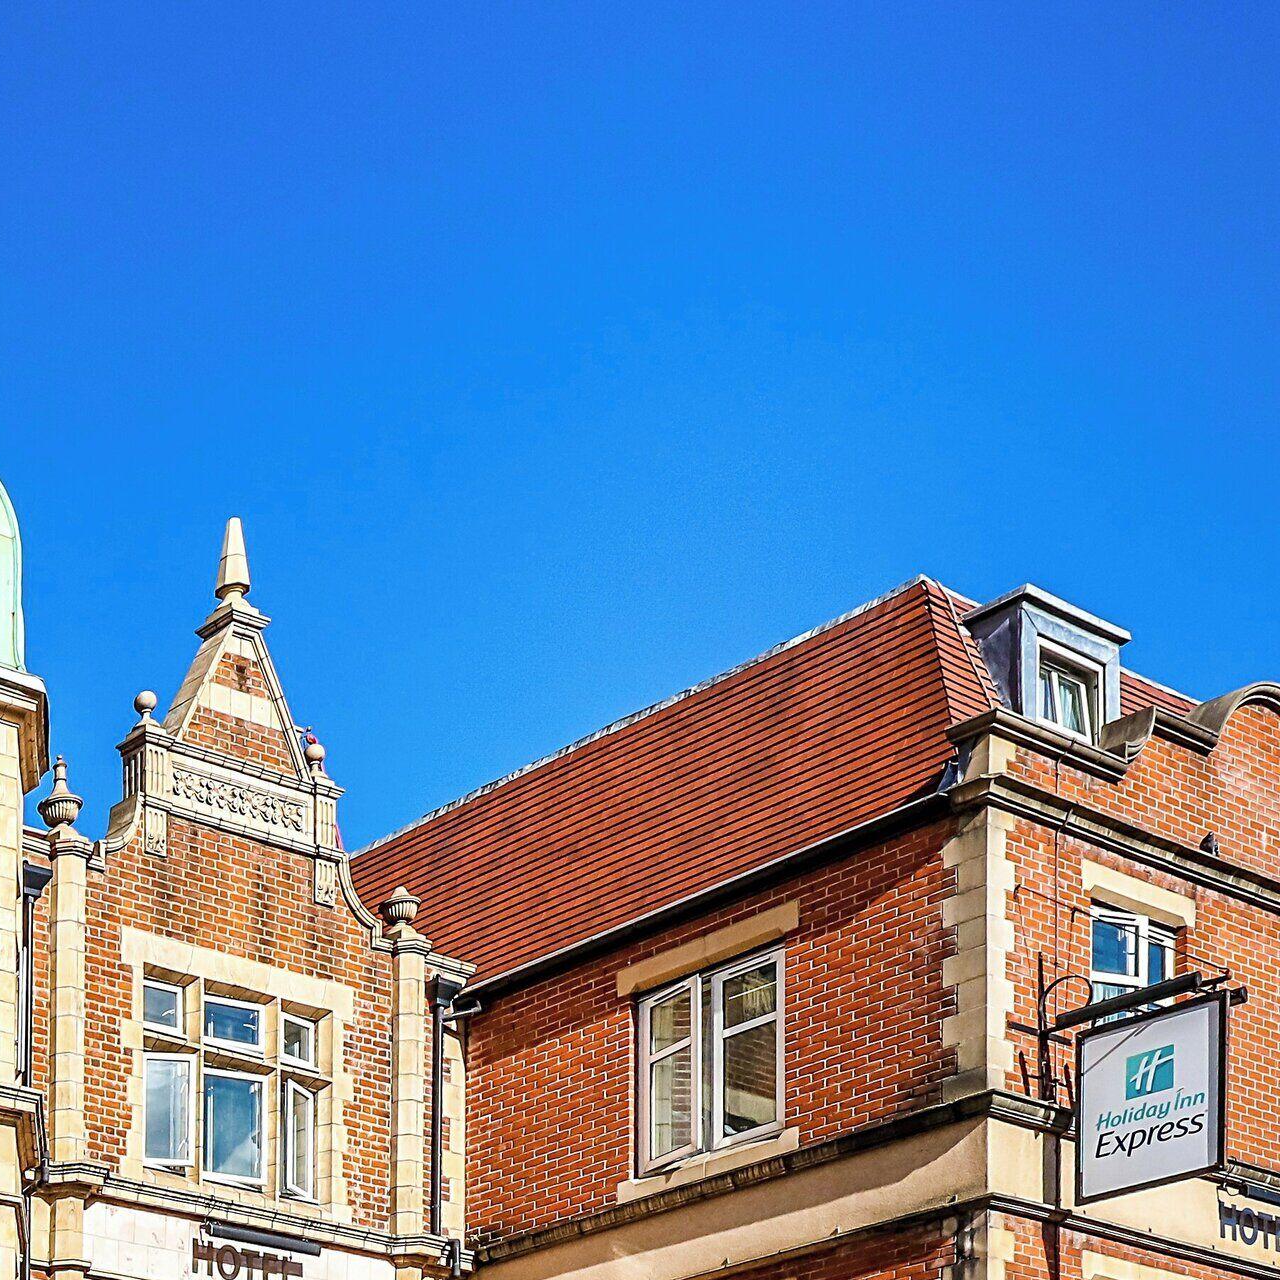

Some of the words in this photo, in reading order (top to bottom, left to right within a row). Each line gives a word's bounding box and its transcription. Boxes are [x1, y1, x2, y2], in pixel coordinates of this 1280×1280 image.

[1096, 1101, 1171, 1132] Holiday
[1174, 1087, 1206, 1112] Inn
[1095, 1113, 1205, 1159] Express
[1219, 1203, 1280, 1252] HOT
